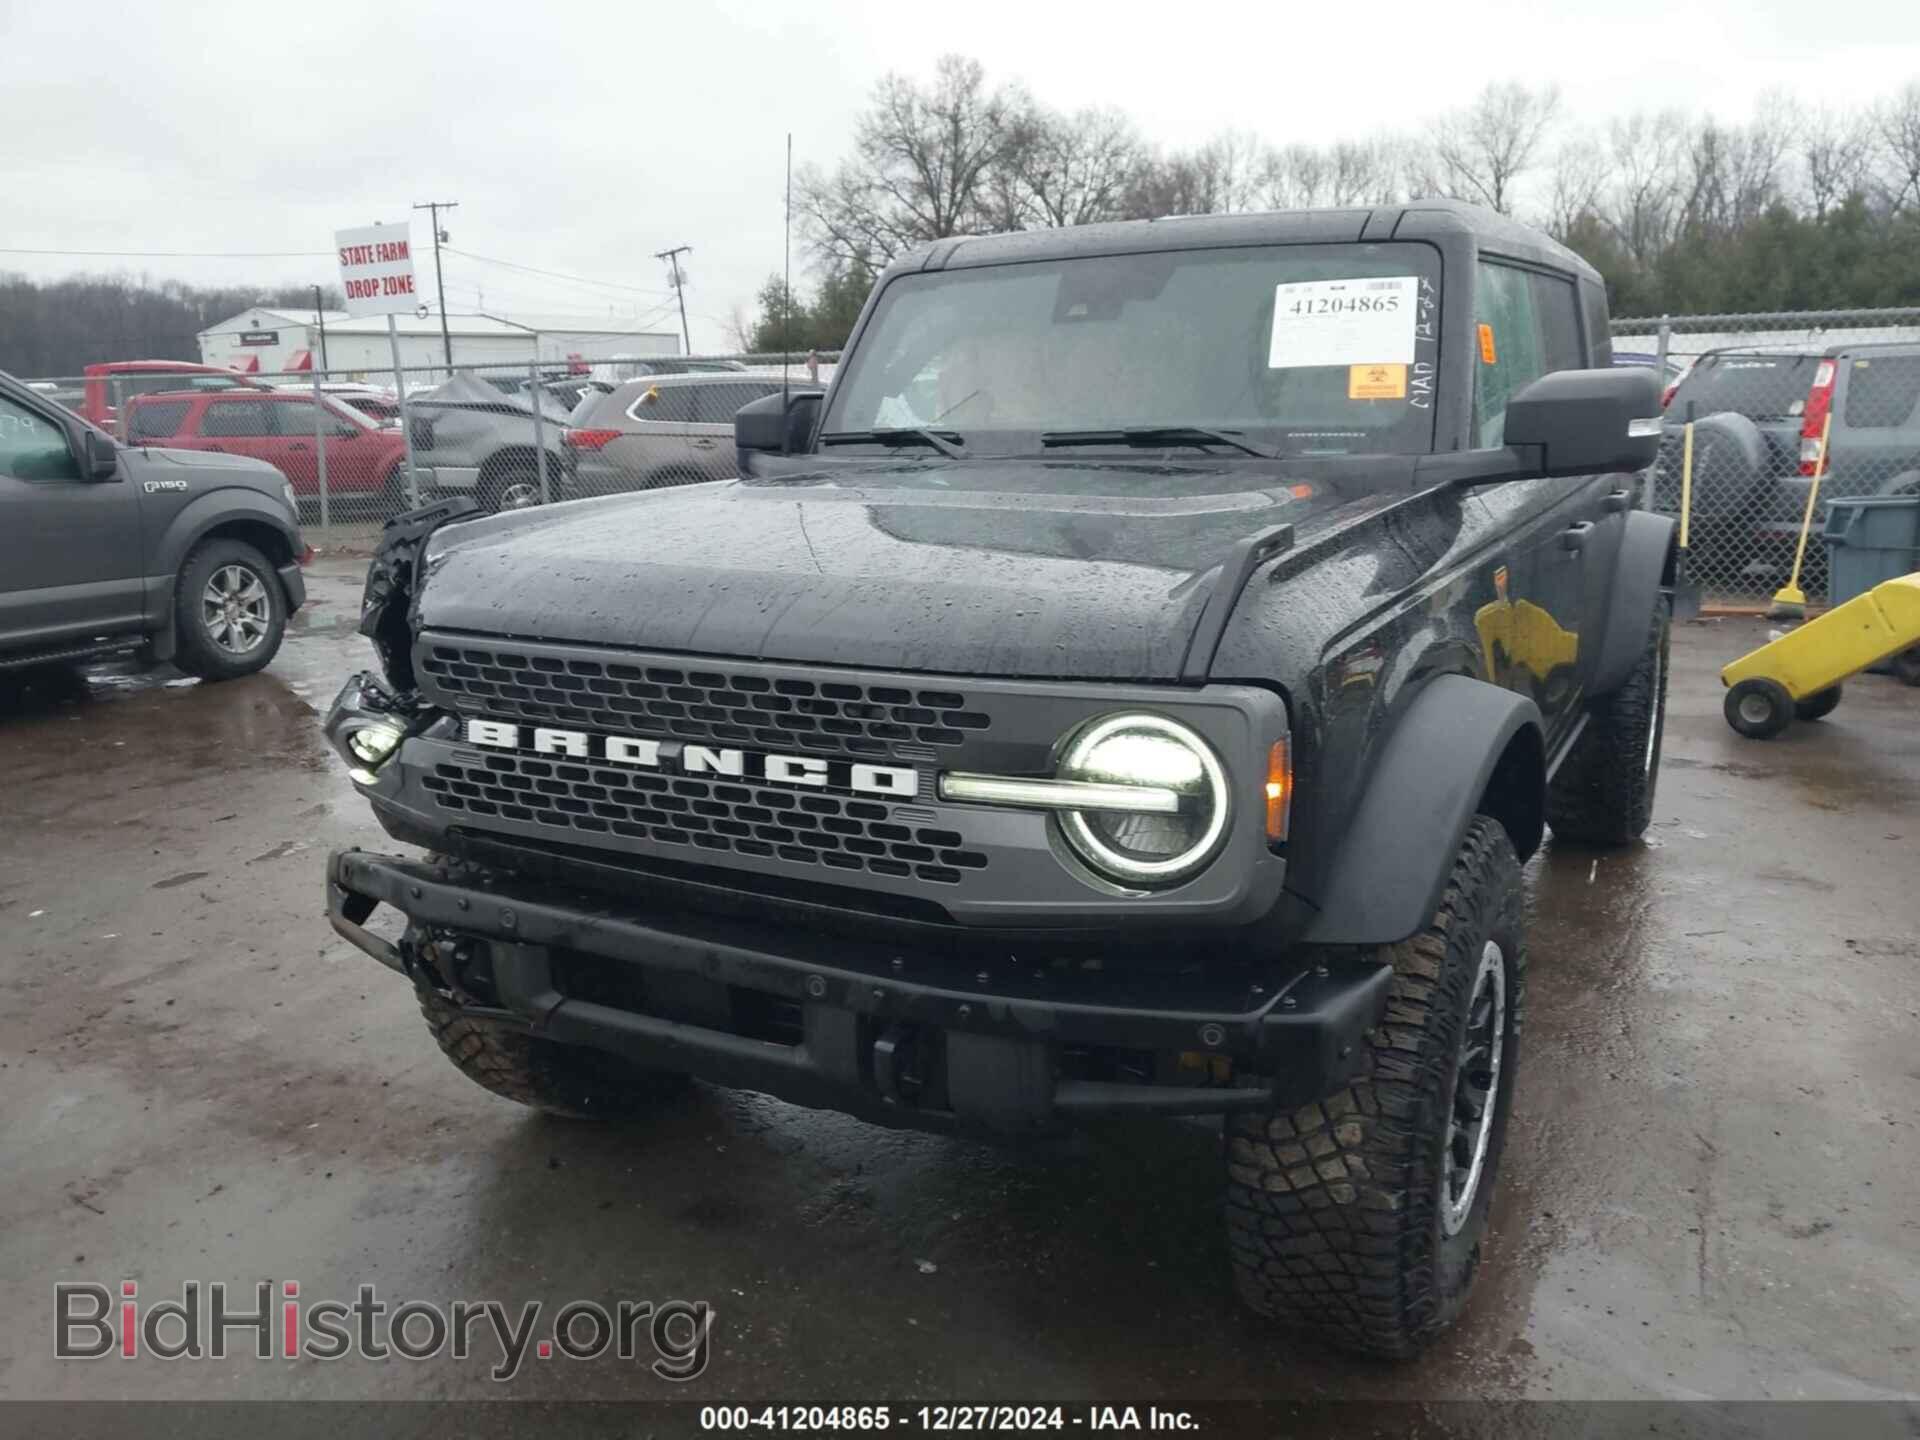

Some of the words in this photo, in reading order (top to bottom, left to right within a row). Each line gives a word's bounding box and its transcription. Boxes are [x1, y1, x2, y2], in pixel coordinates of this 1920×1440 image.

[340, 245, 375, 266] STATE
[376, 240, 409, 262] FARM
[345, 278, 380, 299] DROP
[382, 274, 415, 296] ZONE
[1290, 296, 1399, 314] 41204865
[468, 719, 918, 796] BRONCO
